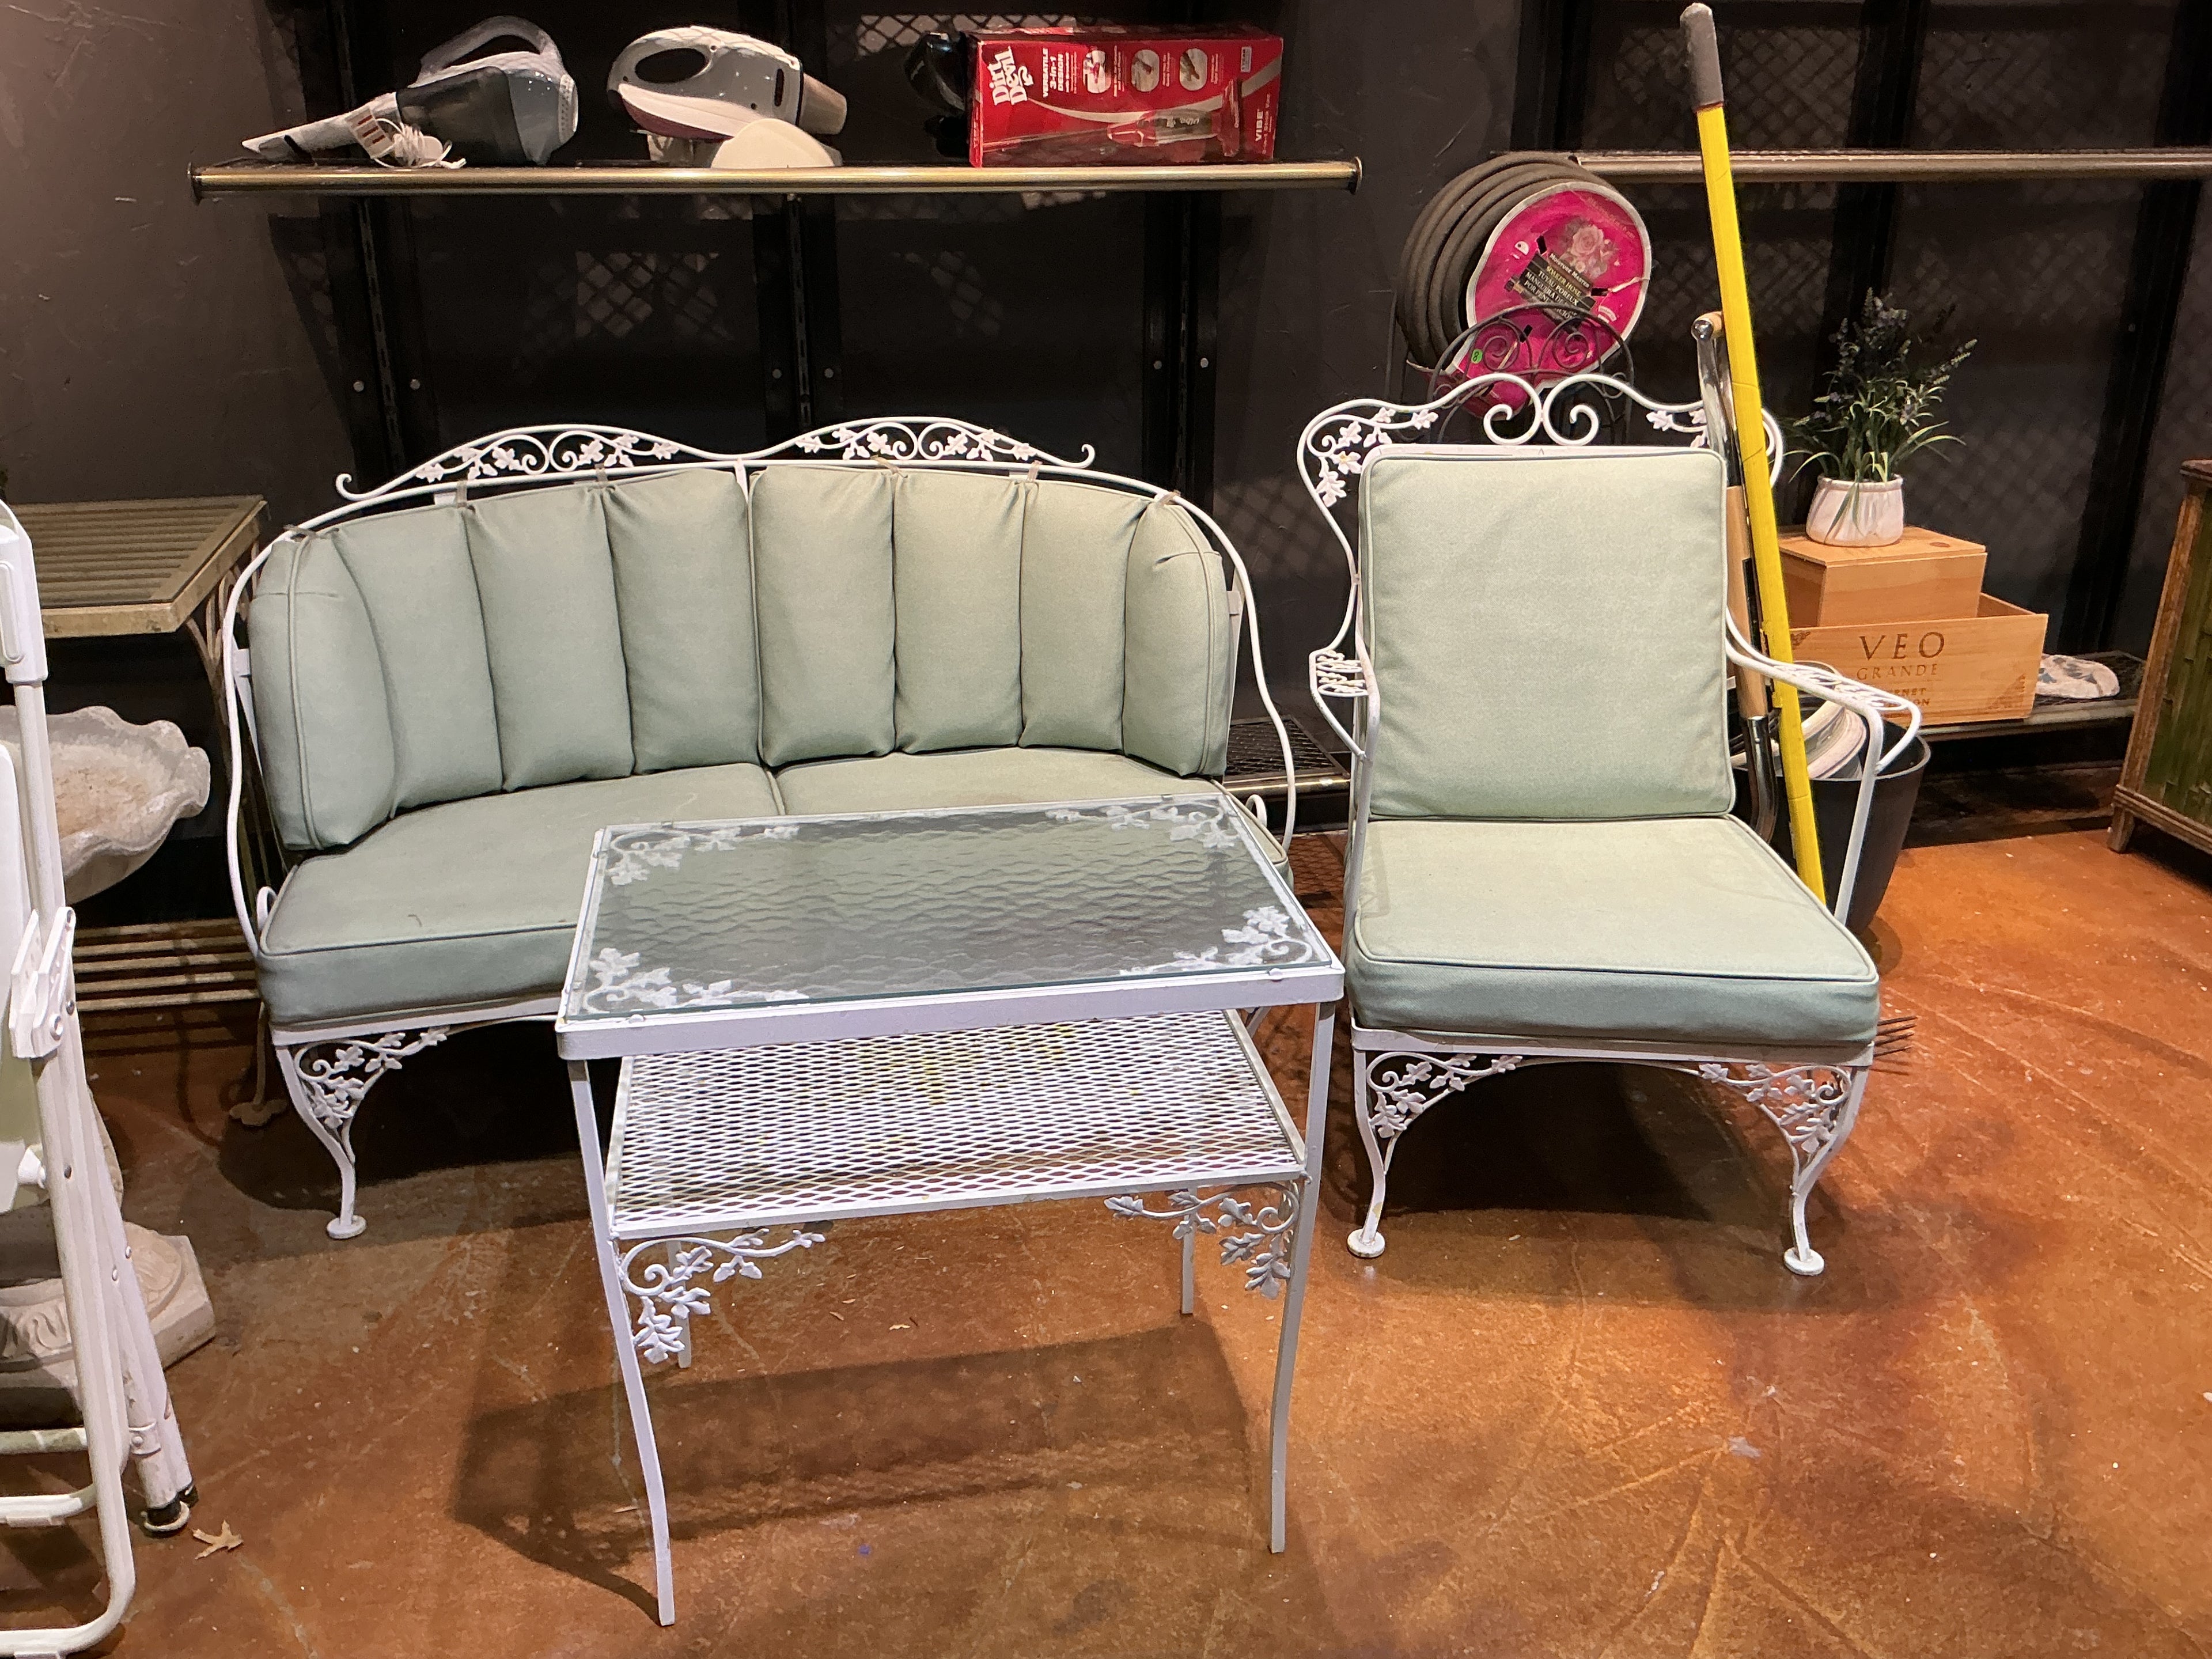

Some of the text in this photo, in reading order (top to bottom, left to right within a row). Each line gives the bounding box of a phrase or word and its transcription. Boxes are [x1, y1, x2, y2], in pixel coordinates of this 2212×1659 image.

[987, 62, 1010, 106] Dirt
[995, 46, 1028, 105] Devil
[1255, 109, 1263, 142] VIBE
[1547, 266, 1582, 297] SOAKER HOSE
[1859, 631, 1944, 661] VEO
[1857, 663, 1938, 680] GRANDE
